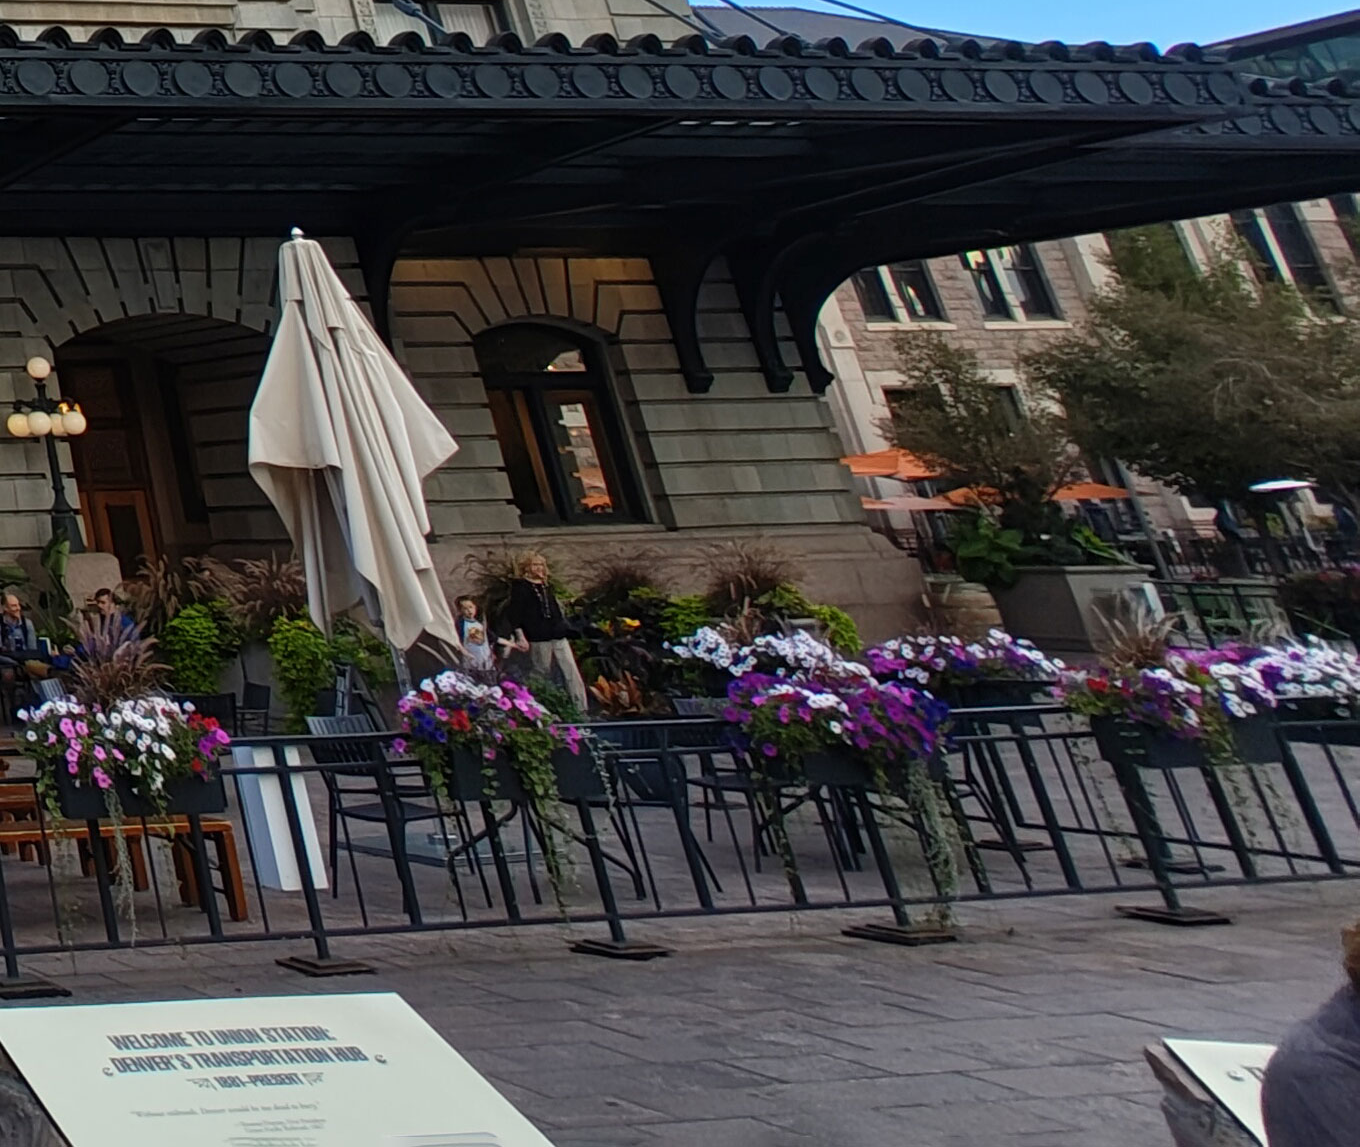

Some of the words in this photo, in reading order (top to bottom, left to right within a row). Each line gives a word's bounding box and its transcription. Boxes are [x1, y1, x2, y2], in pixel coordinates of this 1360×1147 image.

[106, 1031, 192, 1051] WELCOME
[189, 1030, 215, 1047] TO
[212, 1027, 266, 1045] UNION
[260, 1025, 337, 1043] STATION:
[188, 1047, 332, 1069] TRANSPORTATION
[327, 1045, 370, 1063] HUB
